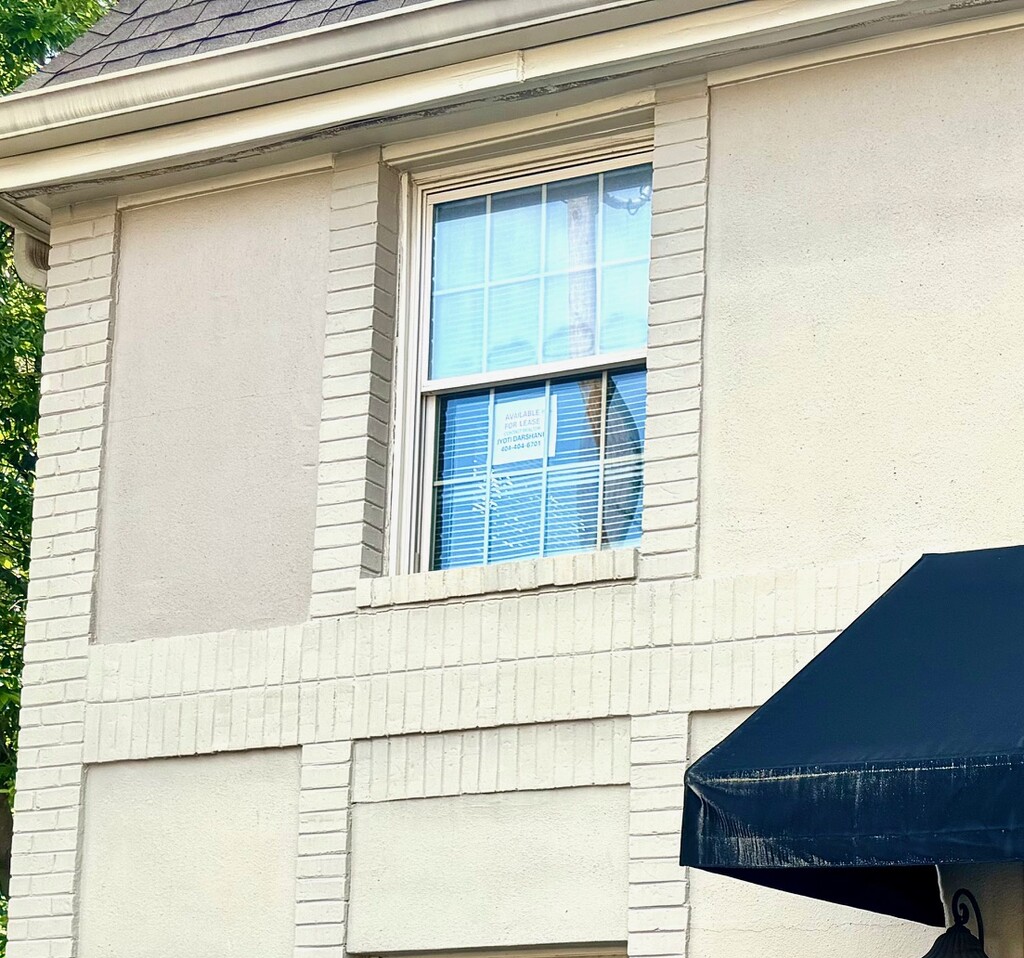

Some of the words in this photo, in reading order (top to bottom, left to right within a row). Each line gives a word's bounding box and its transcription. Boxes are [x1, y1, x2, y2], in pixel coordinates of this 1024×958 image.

[505, 409, 540, 420] AVAILABLE
[504, 421, 518, 430] FOR
[519, 418, 540, 427] LEASE
